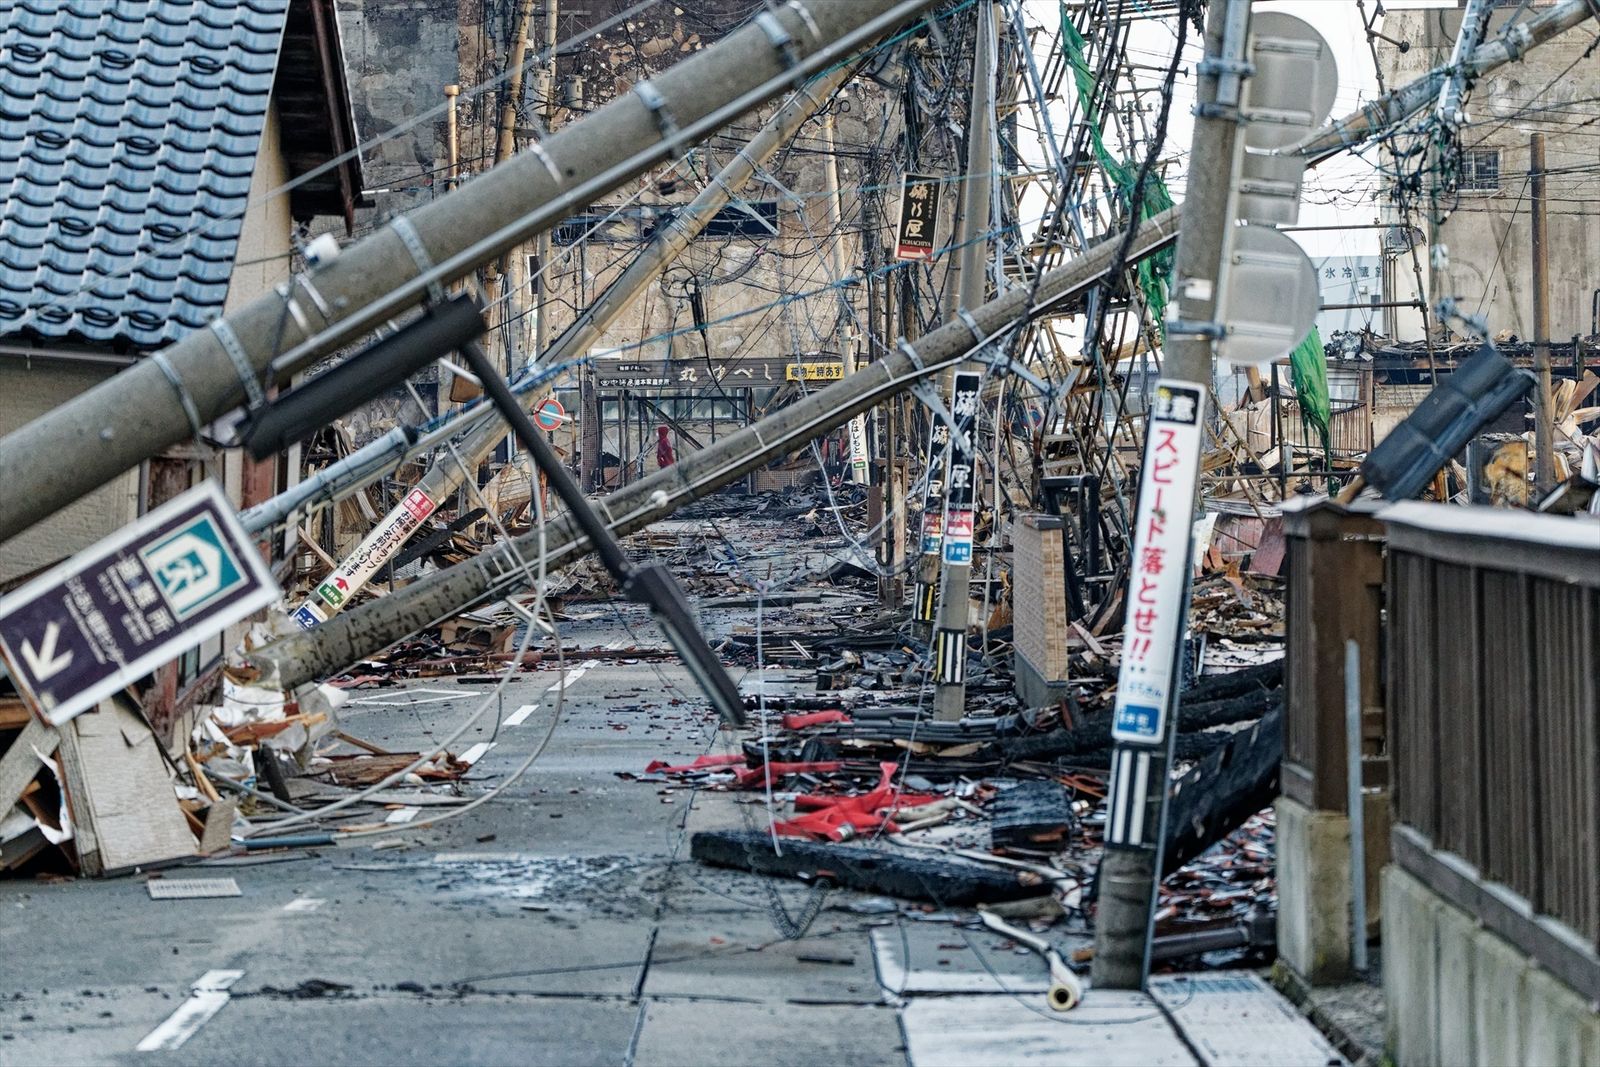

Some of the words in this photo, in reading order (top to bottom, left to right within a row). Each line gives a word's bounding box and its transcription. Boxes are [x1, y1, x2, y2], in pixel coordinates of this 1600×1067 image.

[791, 366, 868, 378] 荷物一時あず
[851, 416, 861, 454] のはしもと
